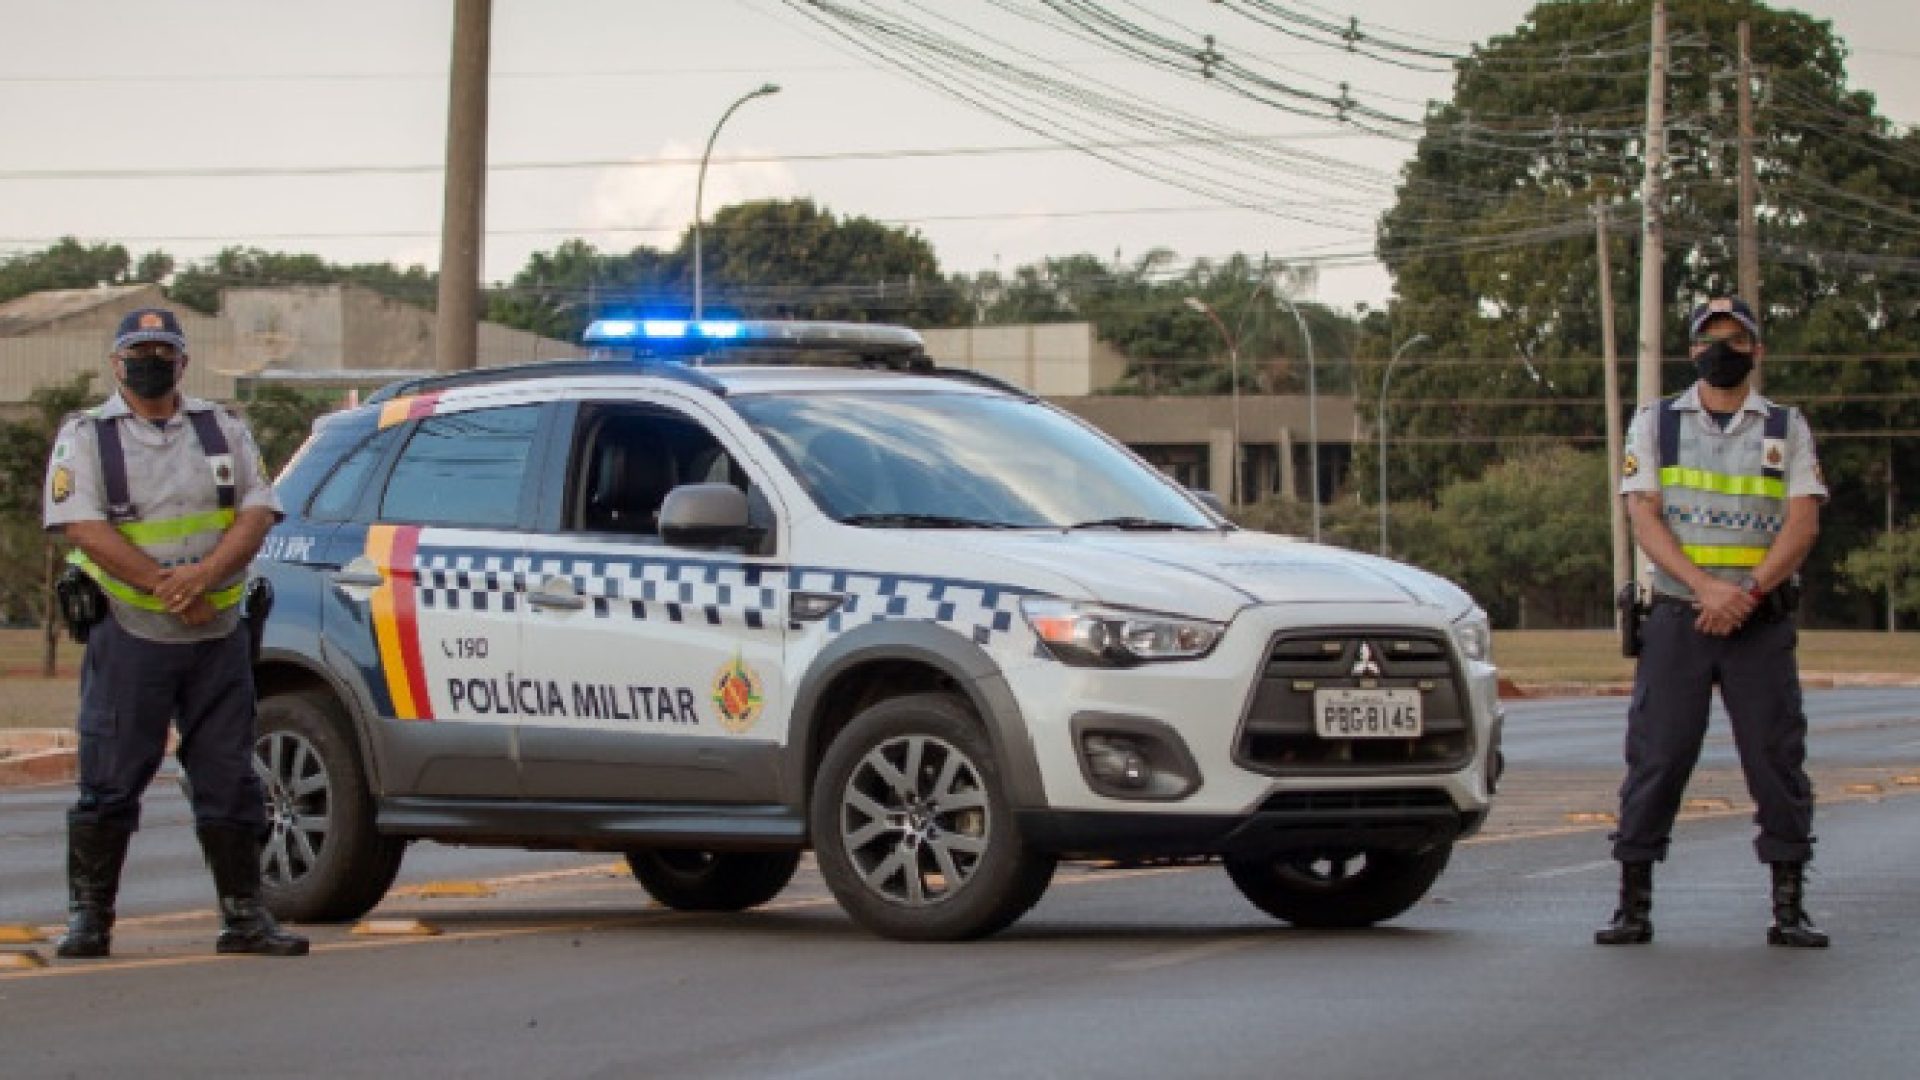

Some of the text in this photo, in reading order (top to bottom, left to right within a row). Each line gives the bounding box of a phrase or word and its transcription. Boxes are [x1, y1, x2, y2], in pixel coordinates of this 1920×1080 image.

[456, 638, 488, 658] 190
[448, 671, 699, 725] POLÍCIA MILITAR
